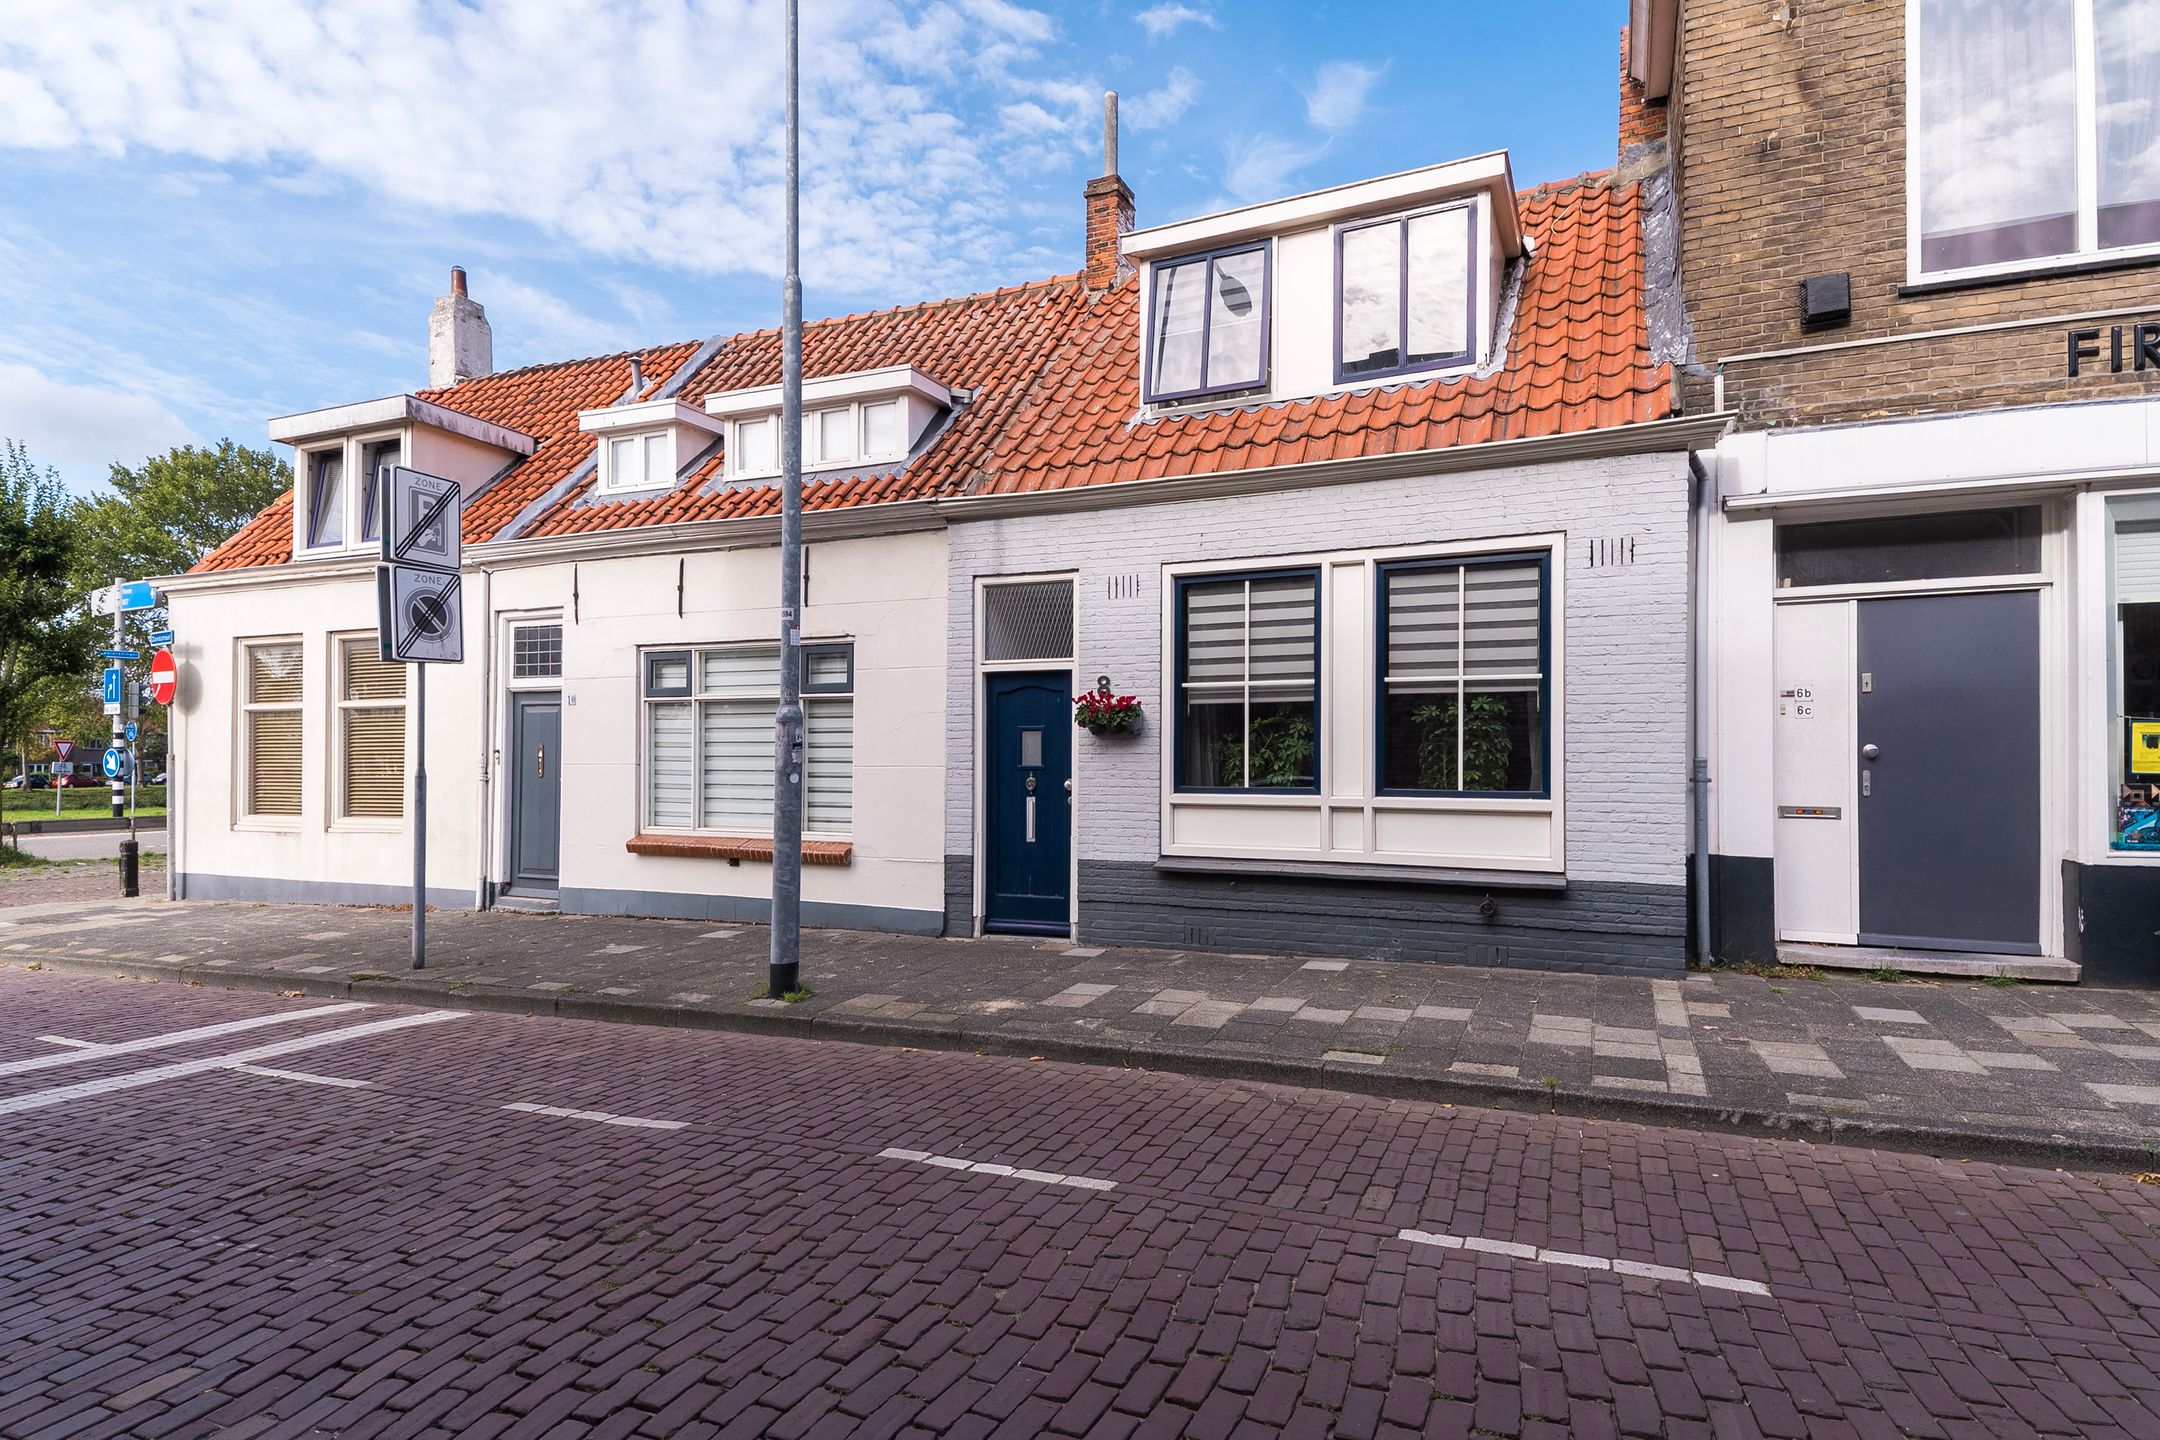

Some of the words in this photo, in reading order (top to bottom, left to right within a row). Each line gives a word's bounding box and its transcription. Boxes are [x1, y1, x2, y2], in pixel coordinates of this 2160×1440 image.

[2067, 322, 2160, 377] FIR
[415, 477, 442, 491] ZONE
[414, 574, 443, 586] ZONE
[1097, 675, 1111, 698] 8
[1796, 688, 1812, 698] 6b
[1797, 705, 1812, 715] 6c
